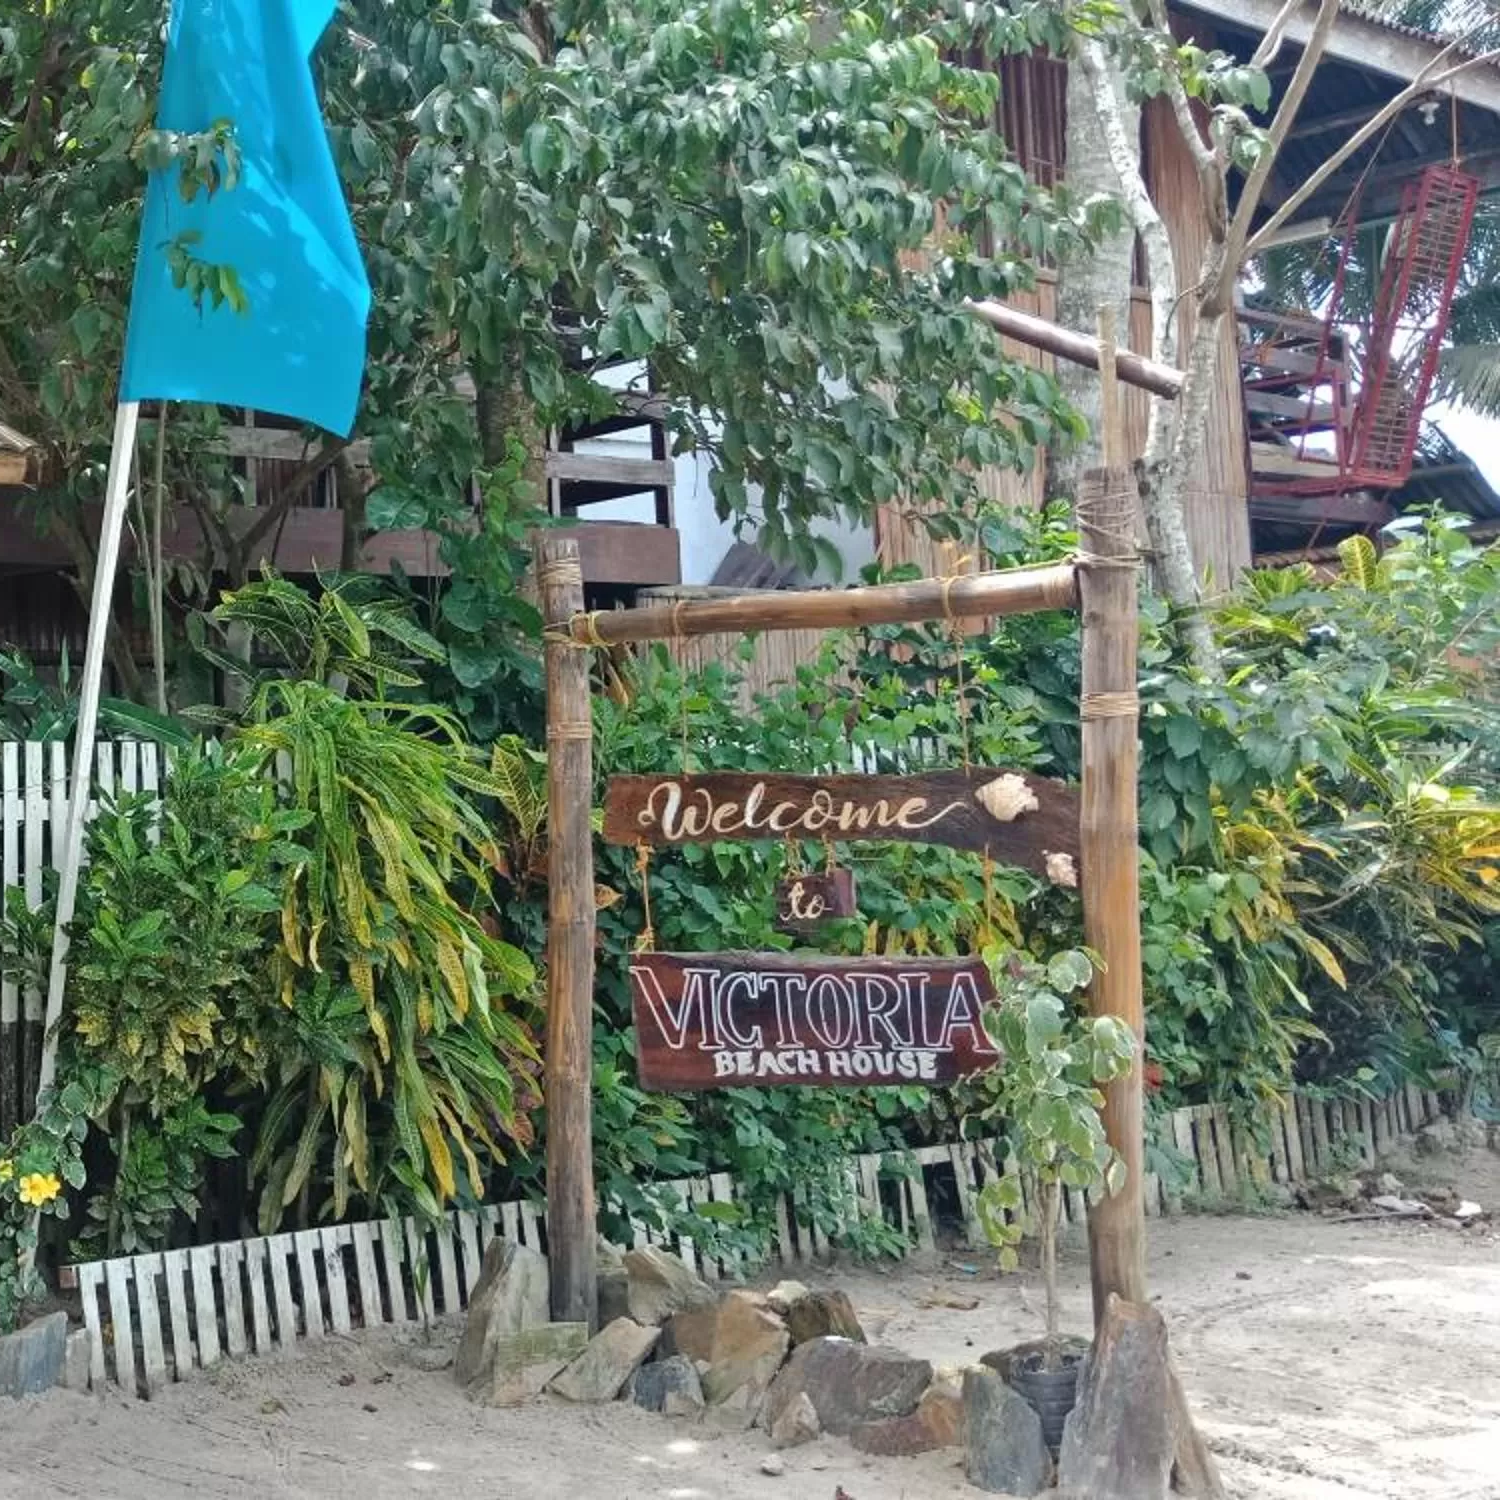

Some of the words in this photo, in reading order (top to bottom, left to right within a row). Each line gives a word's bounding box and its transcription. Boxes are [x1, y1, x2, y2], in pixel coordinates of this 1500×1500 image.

[637, 780, 967, 842] Welcome
[780, 879, 832, 922] to
[629, 965, 1001, 1054] VICTORIA
[713, 1049, 821, 1078] BEACH
[825, 1049, 938, 1080] HOUSE
